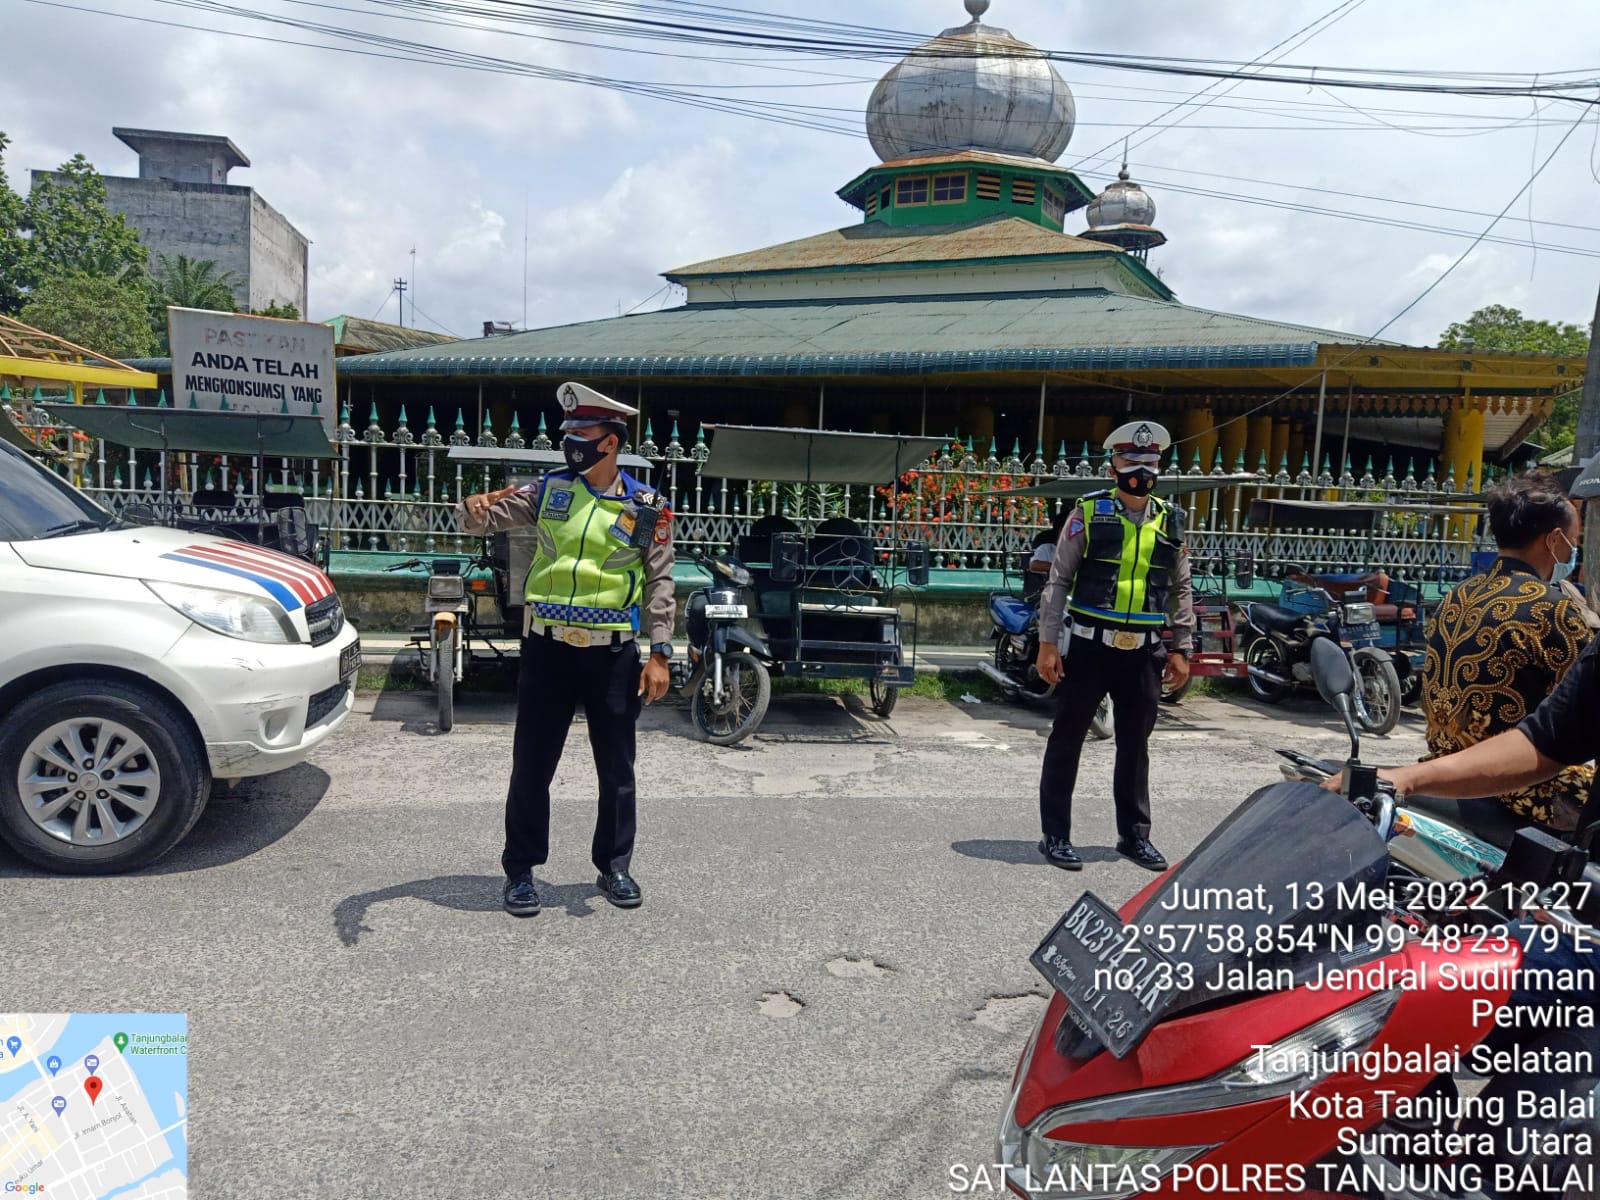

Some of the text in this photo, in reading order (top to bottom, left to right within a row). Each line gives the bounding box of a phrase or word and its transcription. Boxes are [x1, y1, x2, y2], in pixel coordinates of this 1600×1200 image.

[191, 351, 319, 380] ANDA TELAH
[185, 374, 323, 404] MENGKONSUMSI YANG
